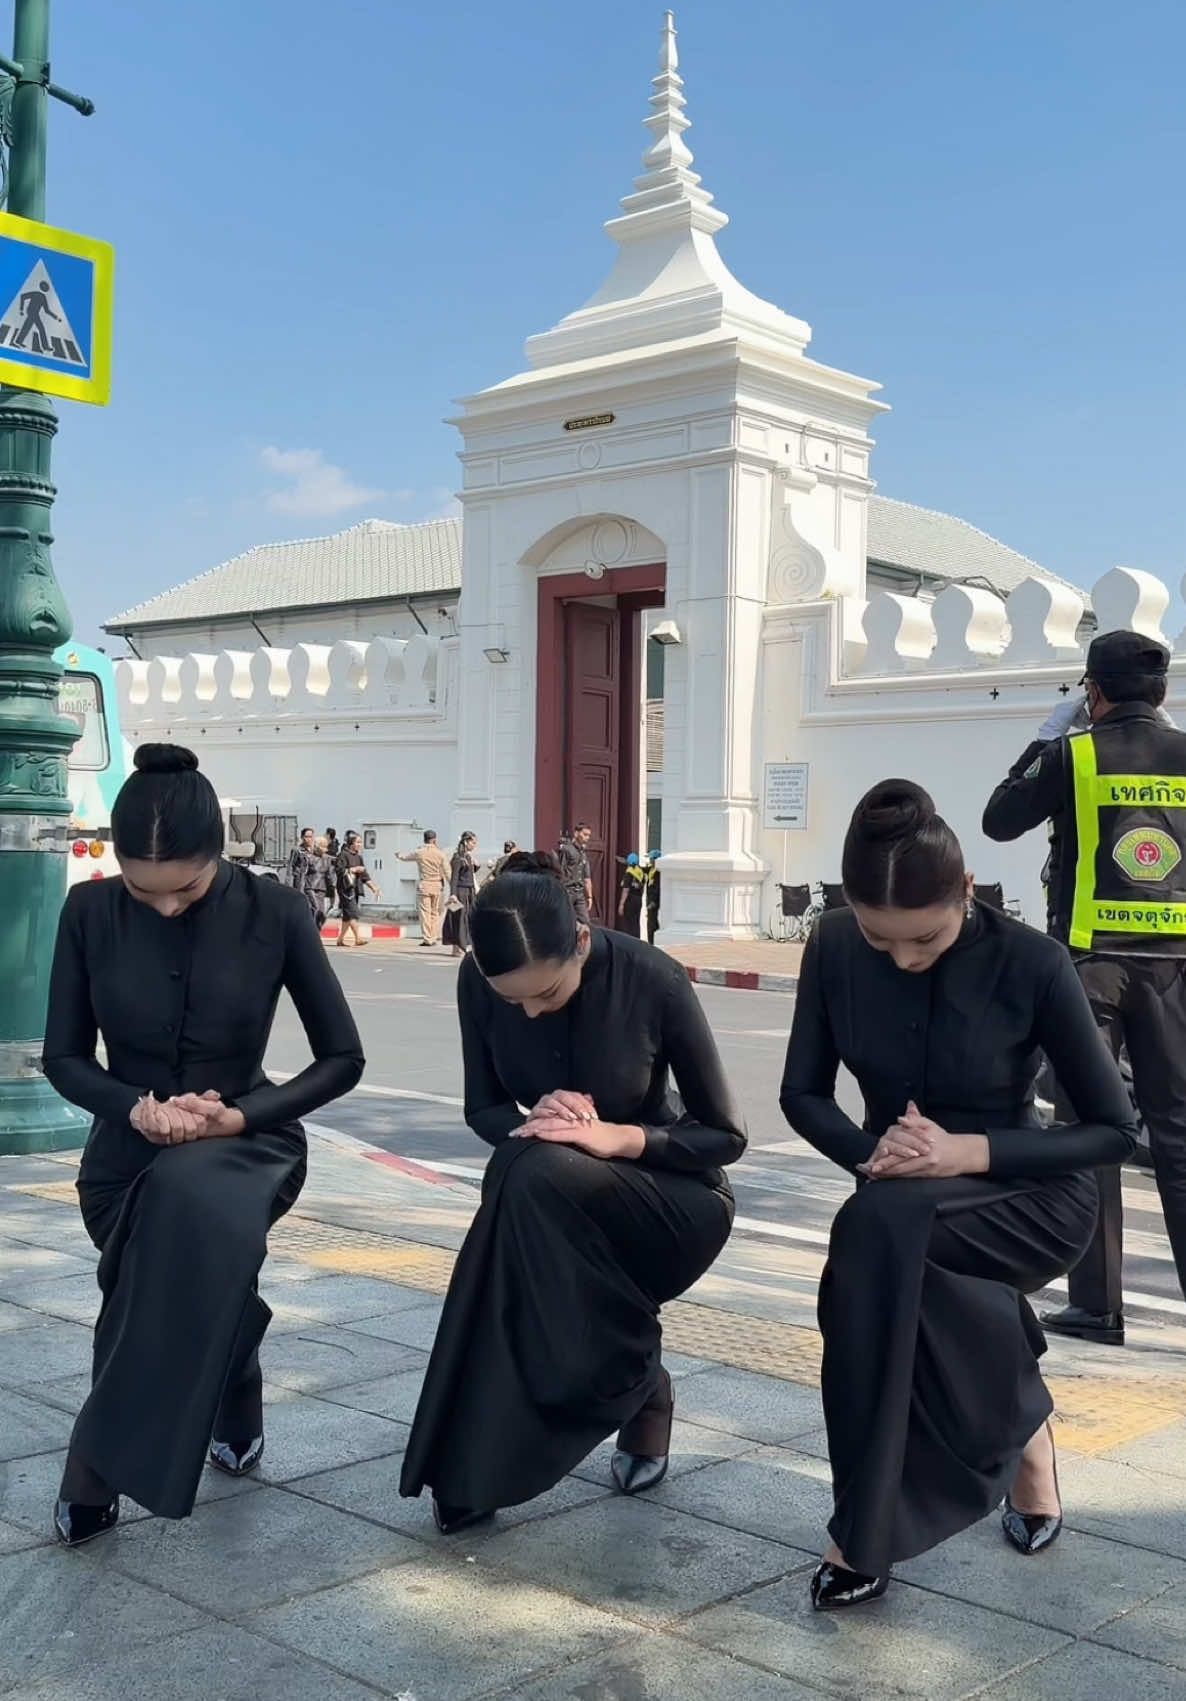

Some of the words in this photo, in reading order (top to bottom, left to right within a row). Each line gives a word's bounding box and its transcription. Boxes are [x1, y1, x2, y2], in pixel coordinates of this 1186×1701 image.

[1111, 780, 1185, 802] เทศกิจ
[1097, 907, 1186, 928] เขตจตุจัก
